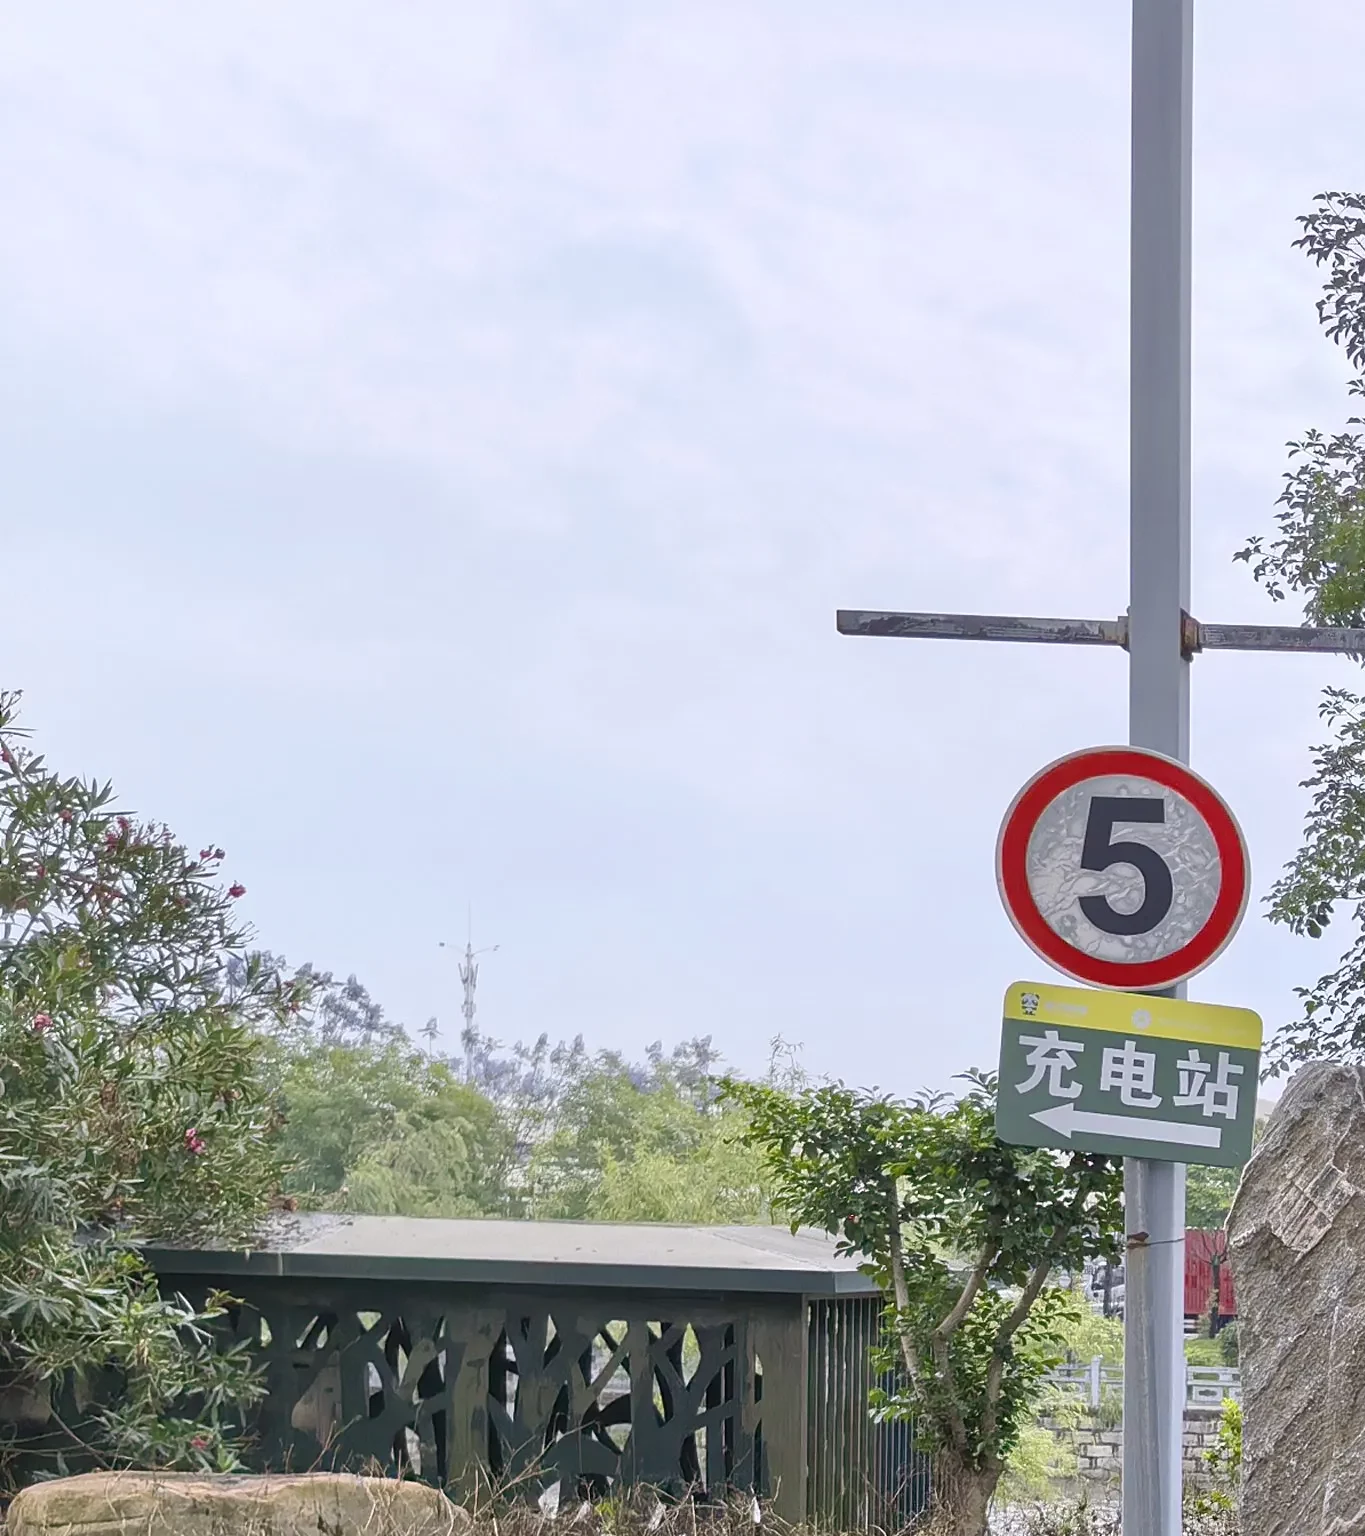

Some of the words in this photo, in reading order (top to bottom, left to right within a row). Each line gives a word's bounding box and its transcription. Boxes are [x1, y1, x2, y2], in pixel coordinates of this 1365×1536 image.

[1078, 796, 1173, 936] 5
[1015, 1031, 1244, 1120] 充电站
